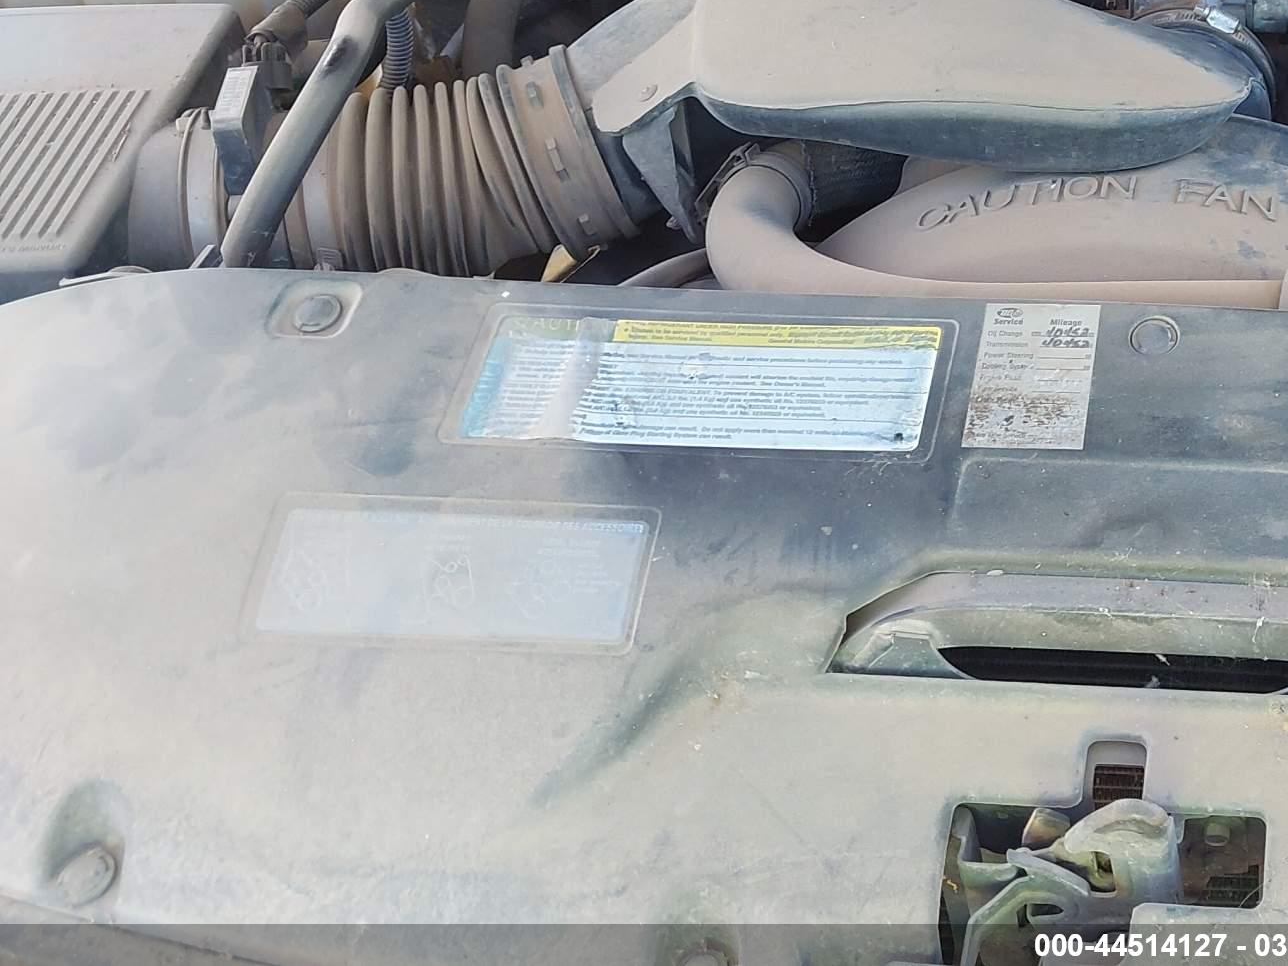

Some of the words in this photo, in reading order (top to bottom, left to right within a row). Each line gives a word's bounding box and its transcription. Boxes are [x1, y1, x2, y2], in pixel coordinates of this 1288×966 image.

[916, 175, 1137, 232] CAUTION
[1175, 177, 1277, 222] FAN
[1050, 318, 1082, 326] Mileage
